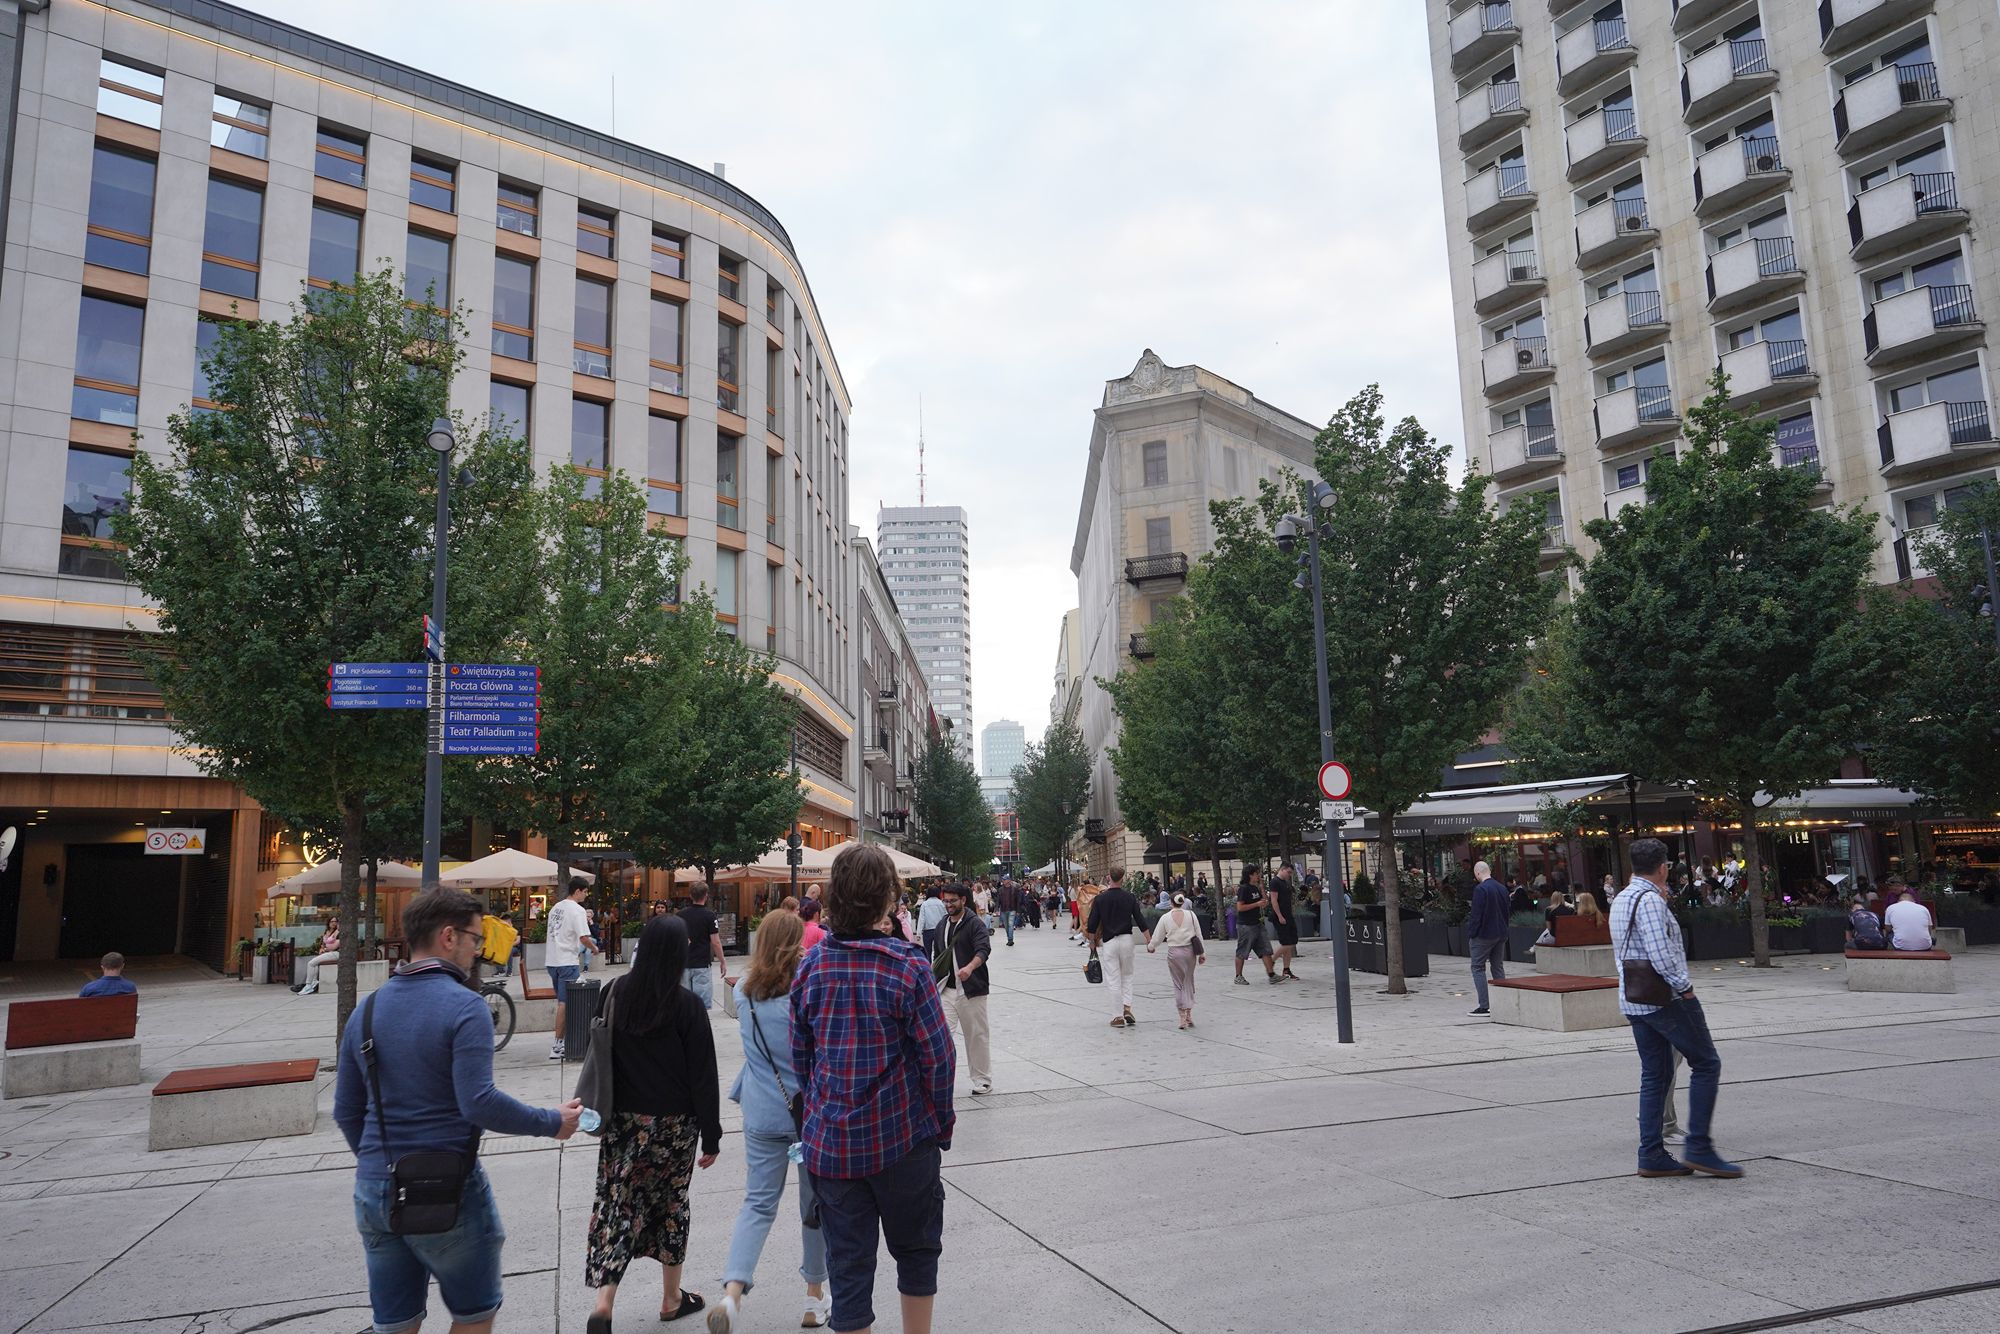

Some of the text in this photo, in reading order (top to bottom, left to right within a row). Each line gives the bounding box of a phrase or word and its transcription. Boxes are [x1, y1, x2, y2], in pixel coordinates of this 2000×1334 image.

[462, 666, 516, 678] Świętokrzyska
[450, 682, 477, 690] Poczta
[480, 681, 513, 691] Główna
[450, 712, 500, 721] Filharmonia
[449, 727, 471, 736] Teatr
[474, 727, 515, 736] Palladium
[154, 837, 160, 845] 5
